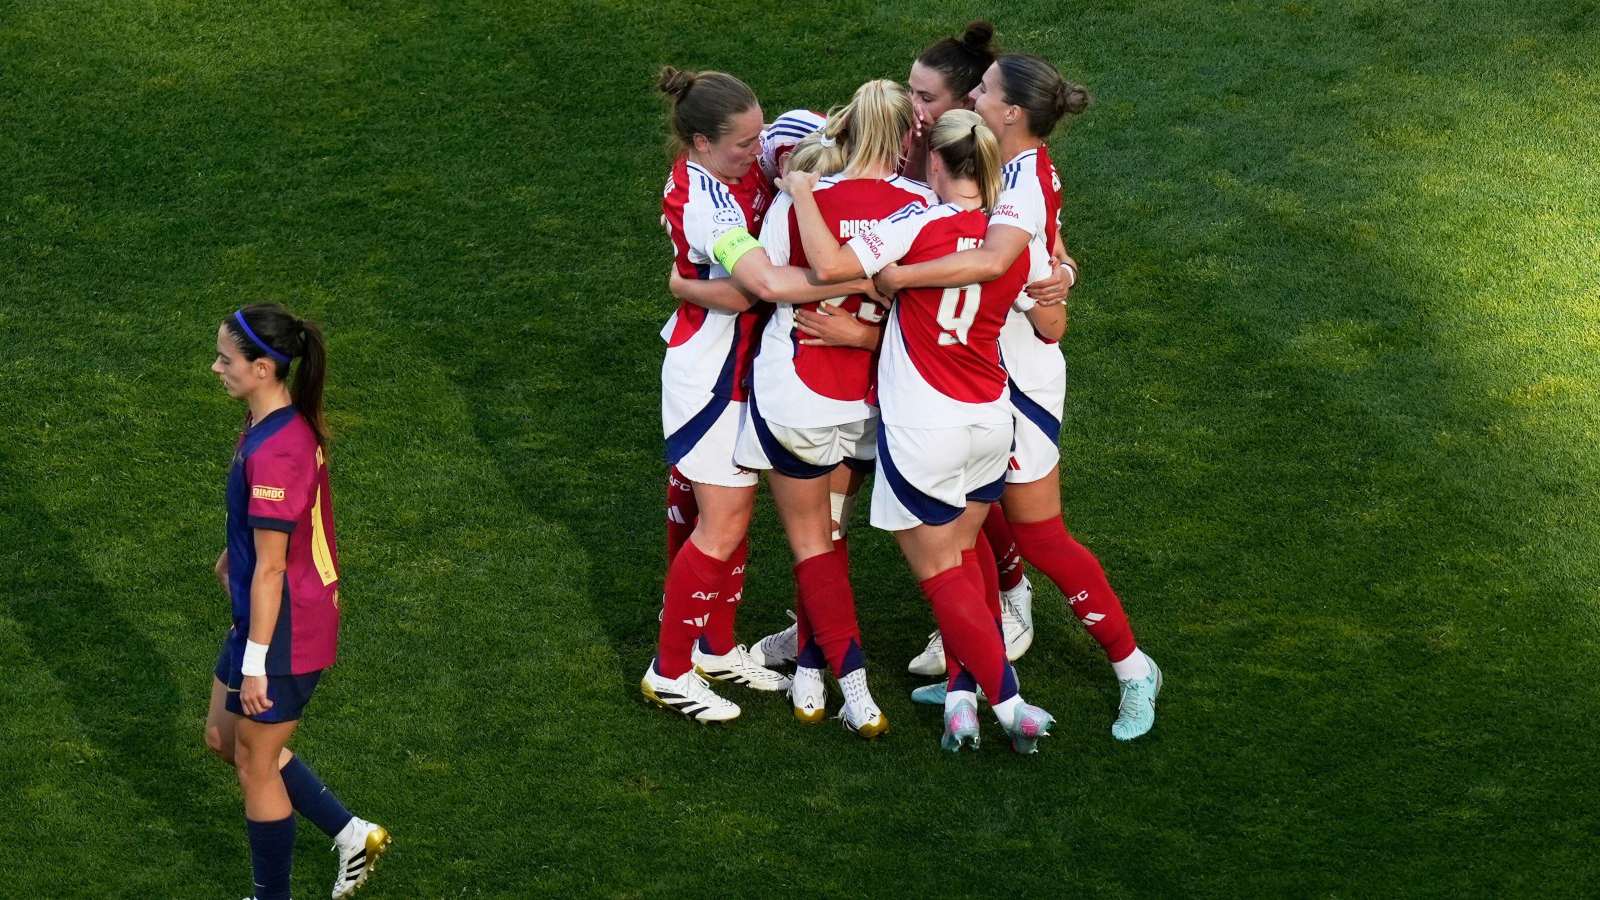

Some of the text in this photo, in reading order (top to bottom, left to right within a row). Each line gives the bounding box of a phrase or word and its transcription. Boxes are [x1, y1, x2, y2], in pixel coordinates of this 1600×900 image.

[869, 231, 885, 247] VISIT
[936, 284, 982, 346] 9
[253, 487, 285, 499] BIMBO
[1068, 590, 1089, 605] FC
